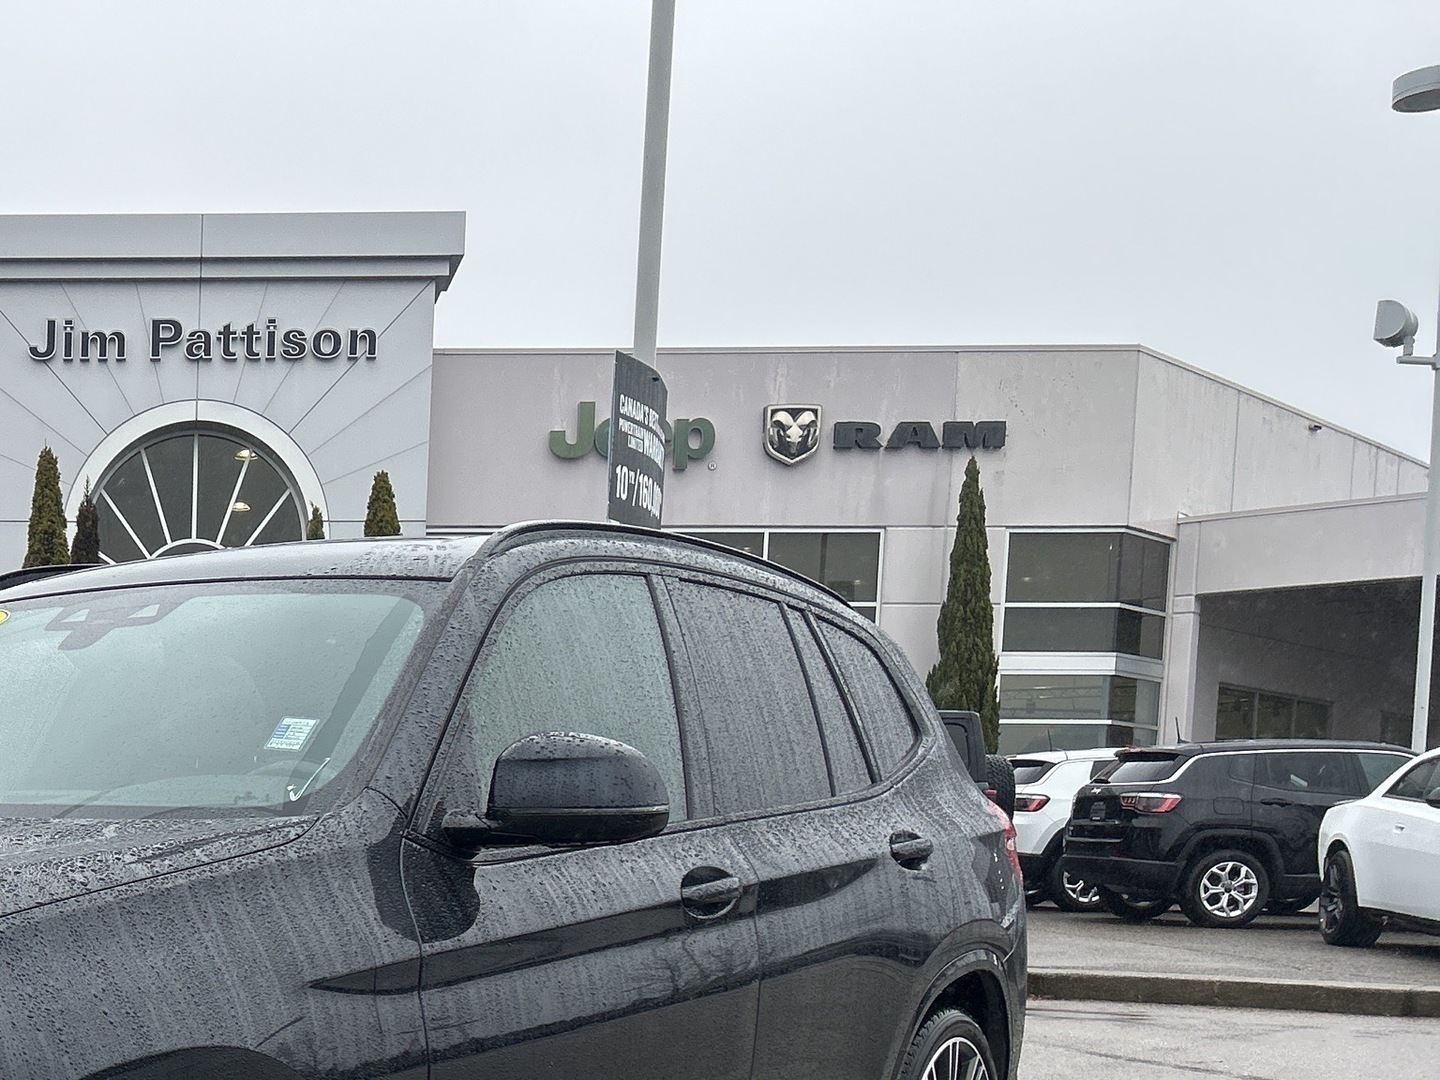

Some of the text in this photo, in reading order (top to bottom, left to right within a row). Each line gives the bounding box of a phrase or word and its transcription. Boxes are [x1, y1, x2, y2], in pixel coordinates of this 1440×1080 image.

[28, 319, 378, 362] Jim Pattison
[548, 402, 716, 471] Jp
[832, 421, 1007, 450] RAM
